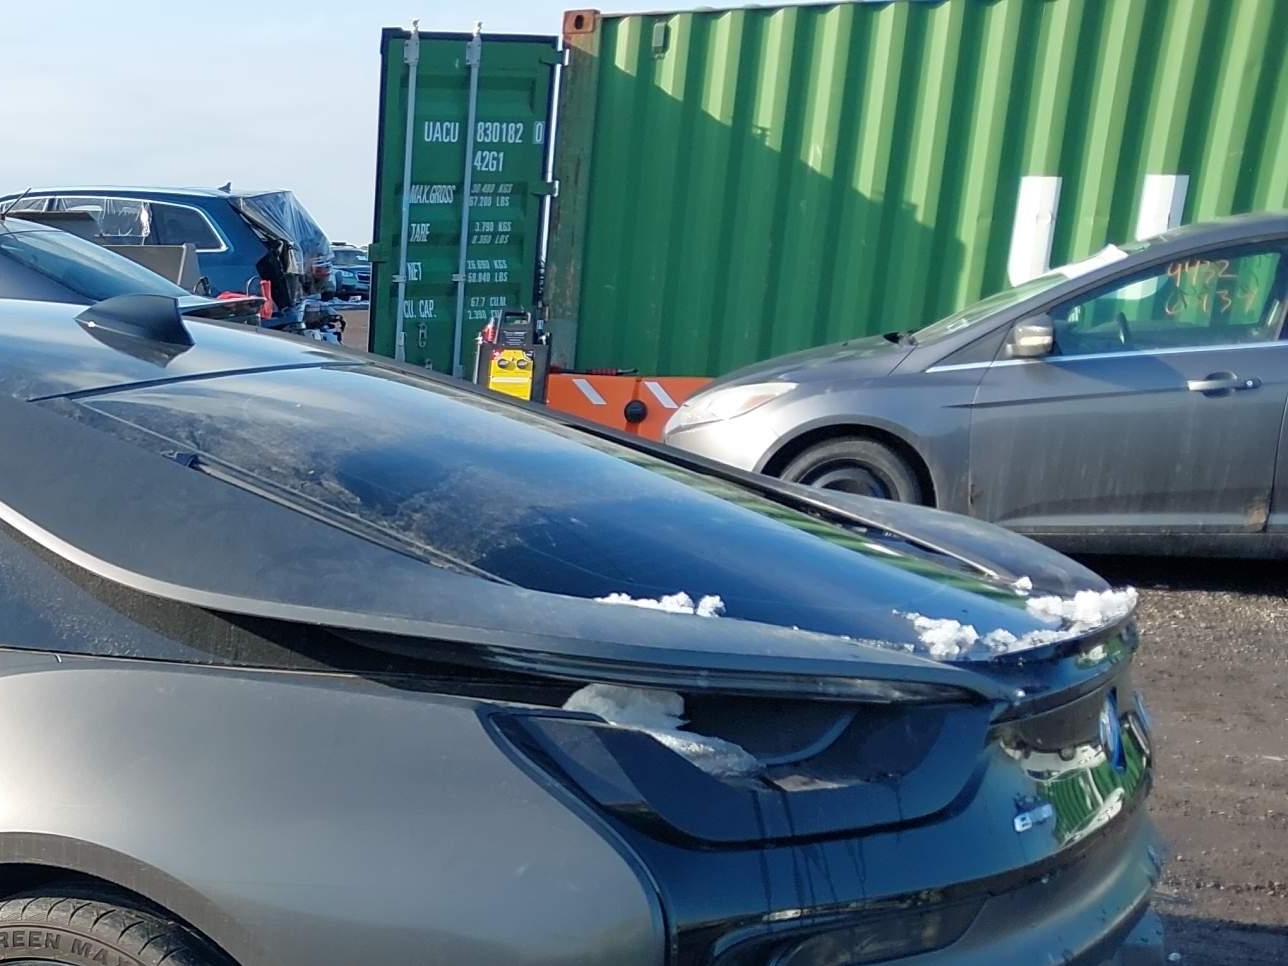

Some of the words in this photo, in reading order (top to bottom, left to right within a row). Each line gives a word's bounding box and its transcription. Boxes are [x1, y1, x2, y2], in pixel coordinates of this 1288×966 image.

[424, 121, 459, 142] UACU
[476, 122, 524, 143] 830182
[534, 122, 544, 143] 0
[473, 150, 504, 172] 42G1
[496, 196, 510, 207] LBS
[409, 223, 430, 242] TARE
[498, 221, 512, 232] KGS
[407, 262, 422, 281] NET
[495, 272, 508, 283] LBS
[419, 299, 438, 318] CAP.
